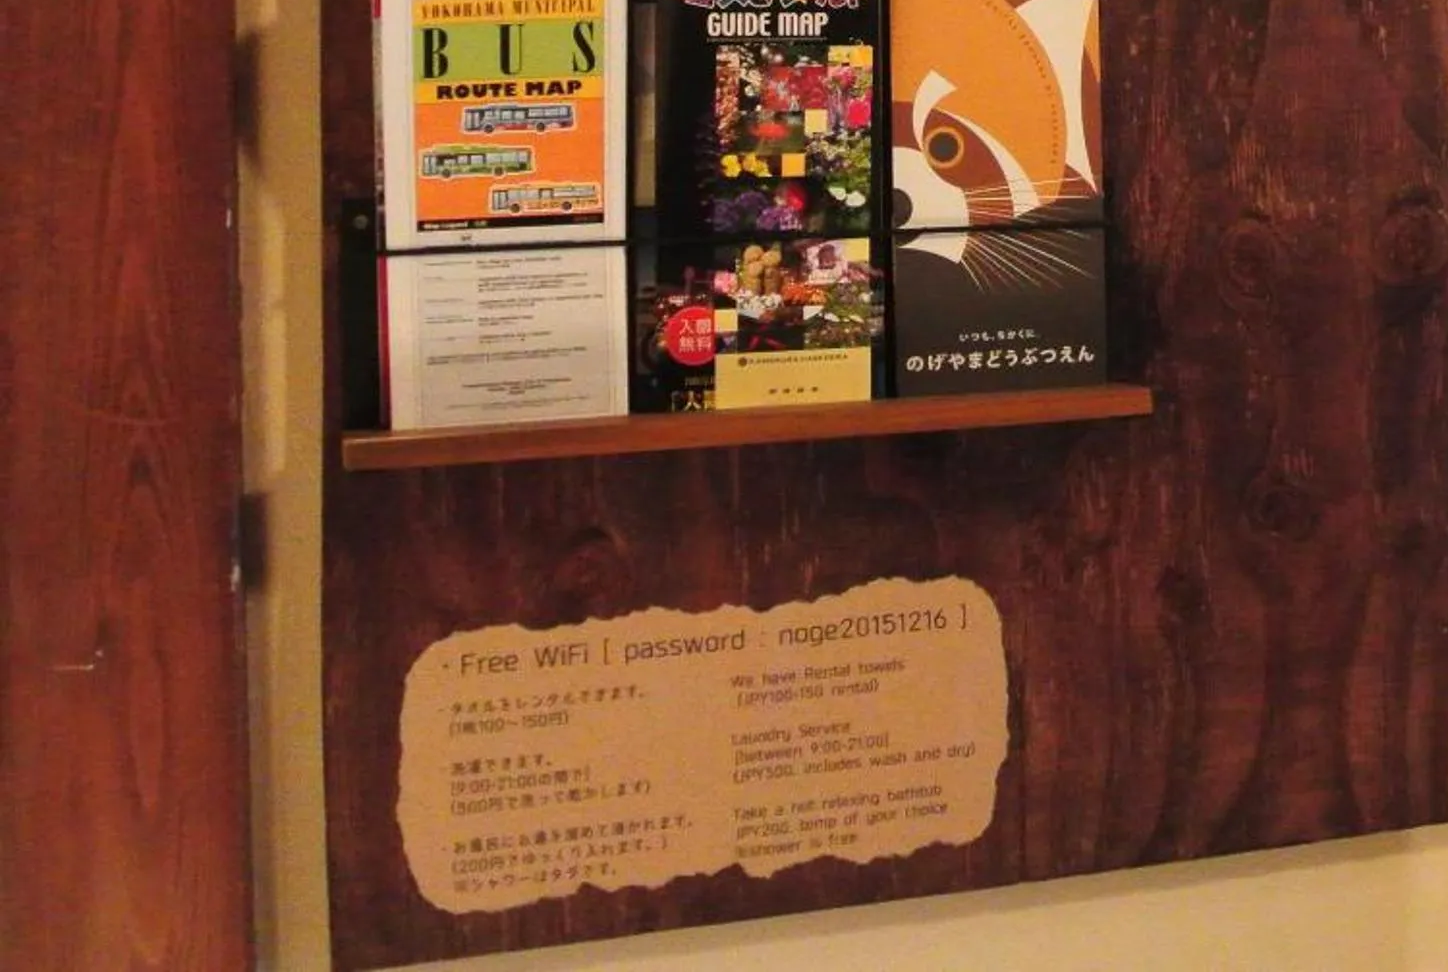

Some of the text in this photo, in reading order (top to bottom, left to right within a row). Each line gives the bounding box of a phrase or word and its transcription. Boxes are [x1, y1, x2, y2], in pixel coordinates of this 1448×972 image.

[421, 2, 504, 19] YOKOHAMA
[707, 12, 829, 37] GUIDE MAP
[422, 20, 596, 79] BUS
[436, 80, 583, 100] ROUTE MAP
[906, 345, 1095, 372] のげやまどうぶつえん
[460, 653, 519, 676] Free
[534, 643, 588, 668] WiFi
[625, 630, 745, 666] password
[778, 608, 947, 647] noge20151216
